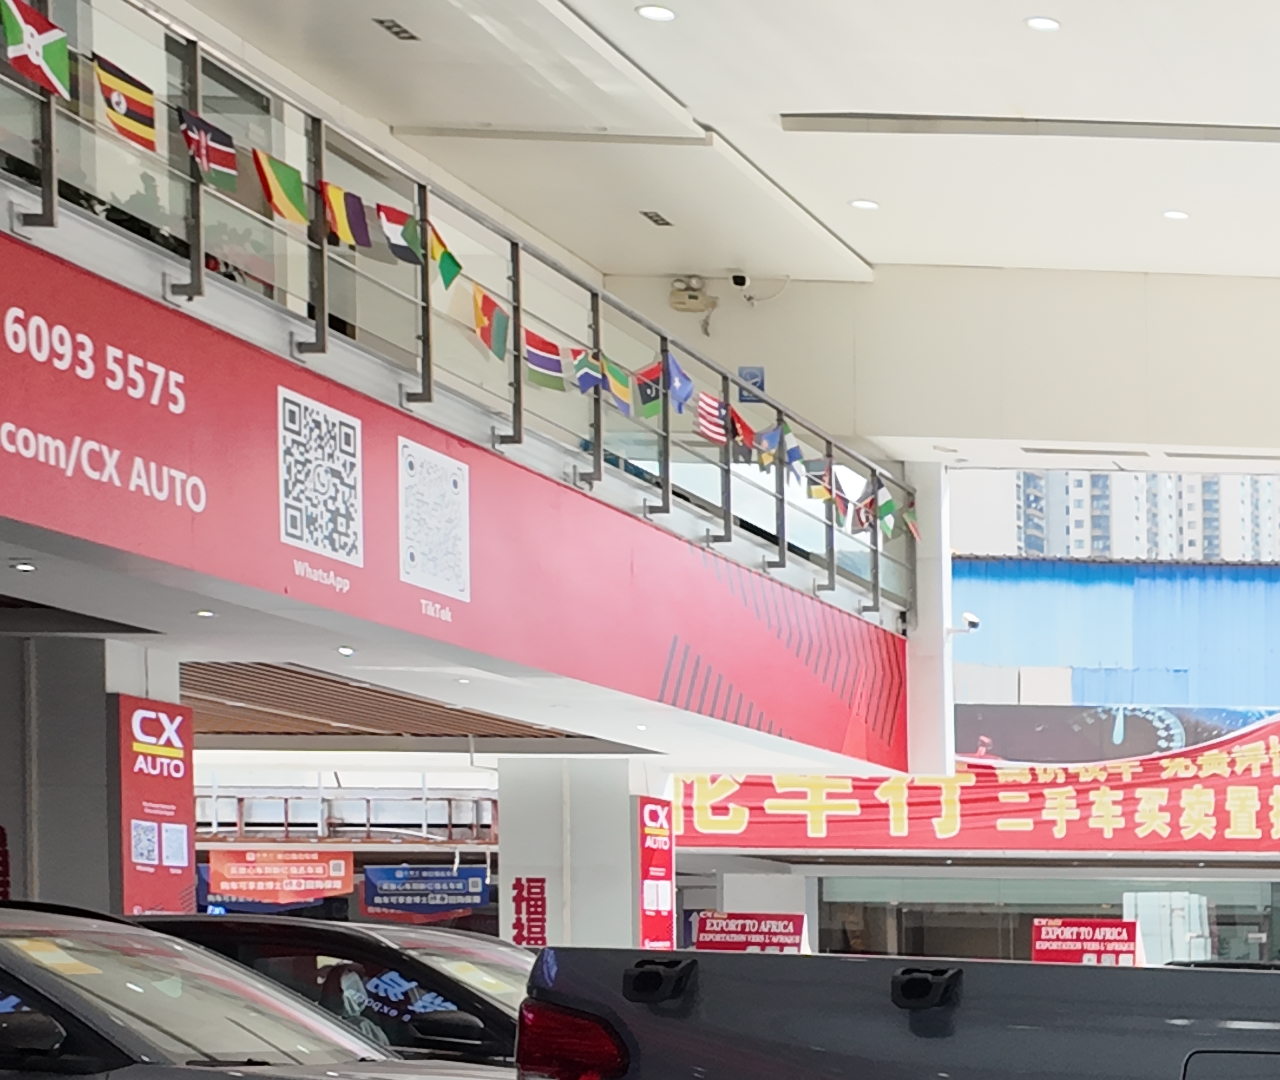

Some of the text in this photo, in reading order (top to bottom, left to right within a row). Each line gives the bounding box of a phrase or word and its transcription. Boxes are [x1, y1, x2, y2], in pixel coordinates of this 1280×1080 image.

[4, 306, 186, 415] 6093 5575
[0, 422, 207, 513] com/CX AUTO
[293, 559, 350, 594] WhatsApp
[420, 598, 452, 622] TikTok
[131, 709, 184, 748] CX
[133, 754, 184, 778] AUTO
[643, 803, 669, 829] CX
[645, 835, 670, 851] AUTO
[705, 919, 794, 933] EXPORT TO AFRICA
[1041, 926, 1128, 940] EXPORT TO AFRICA
